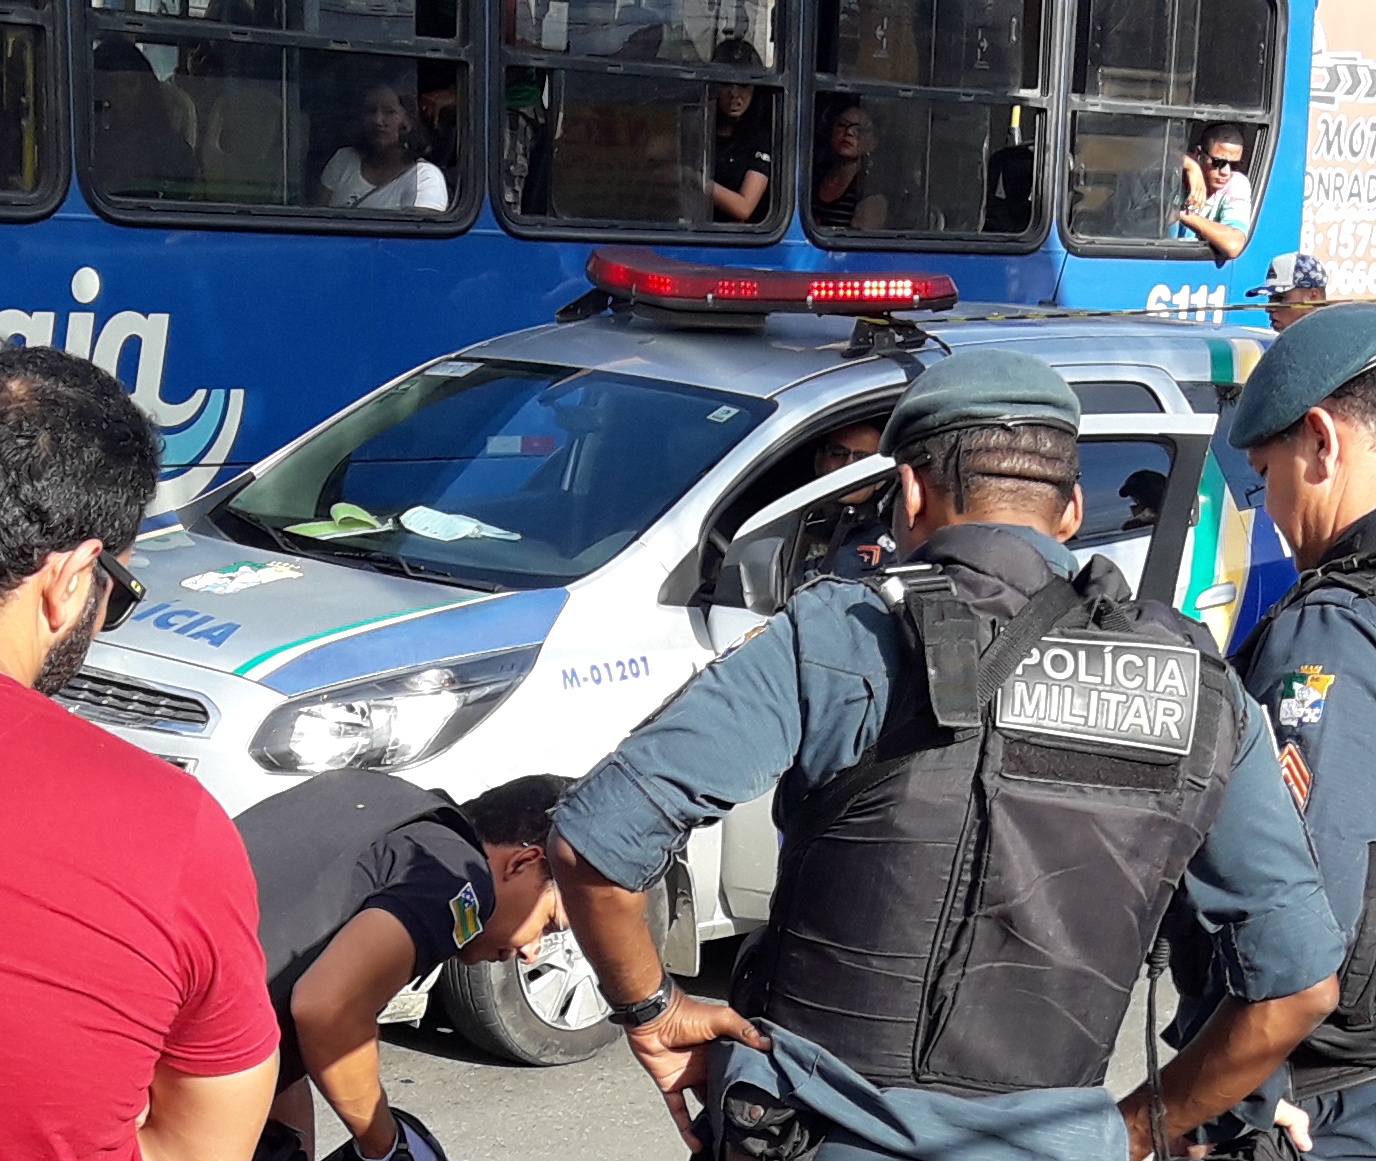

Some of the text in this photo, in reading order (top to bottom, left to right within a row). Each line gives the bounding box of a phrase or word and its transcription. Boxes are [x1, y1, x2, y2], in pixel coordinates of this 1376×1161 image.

[1146, 283, 1226, 324] 6111
[562, 656, 649, 690] M-01201
[1015, 646, 1187, 697] POLÍCIA
[1012, 681, 1185, 740] MILITAR
